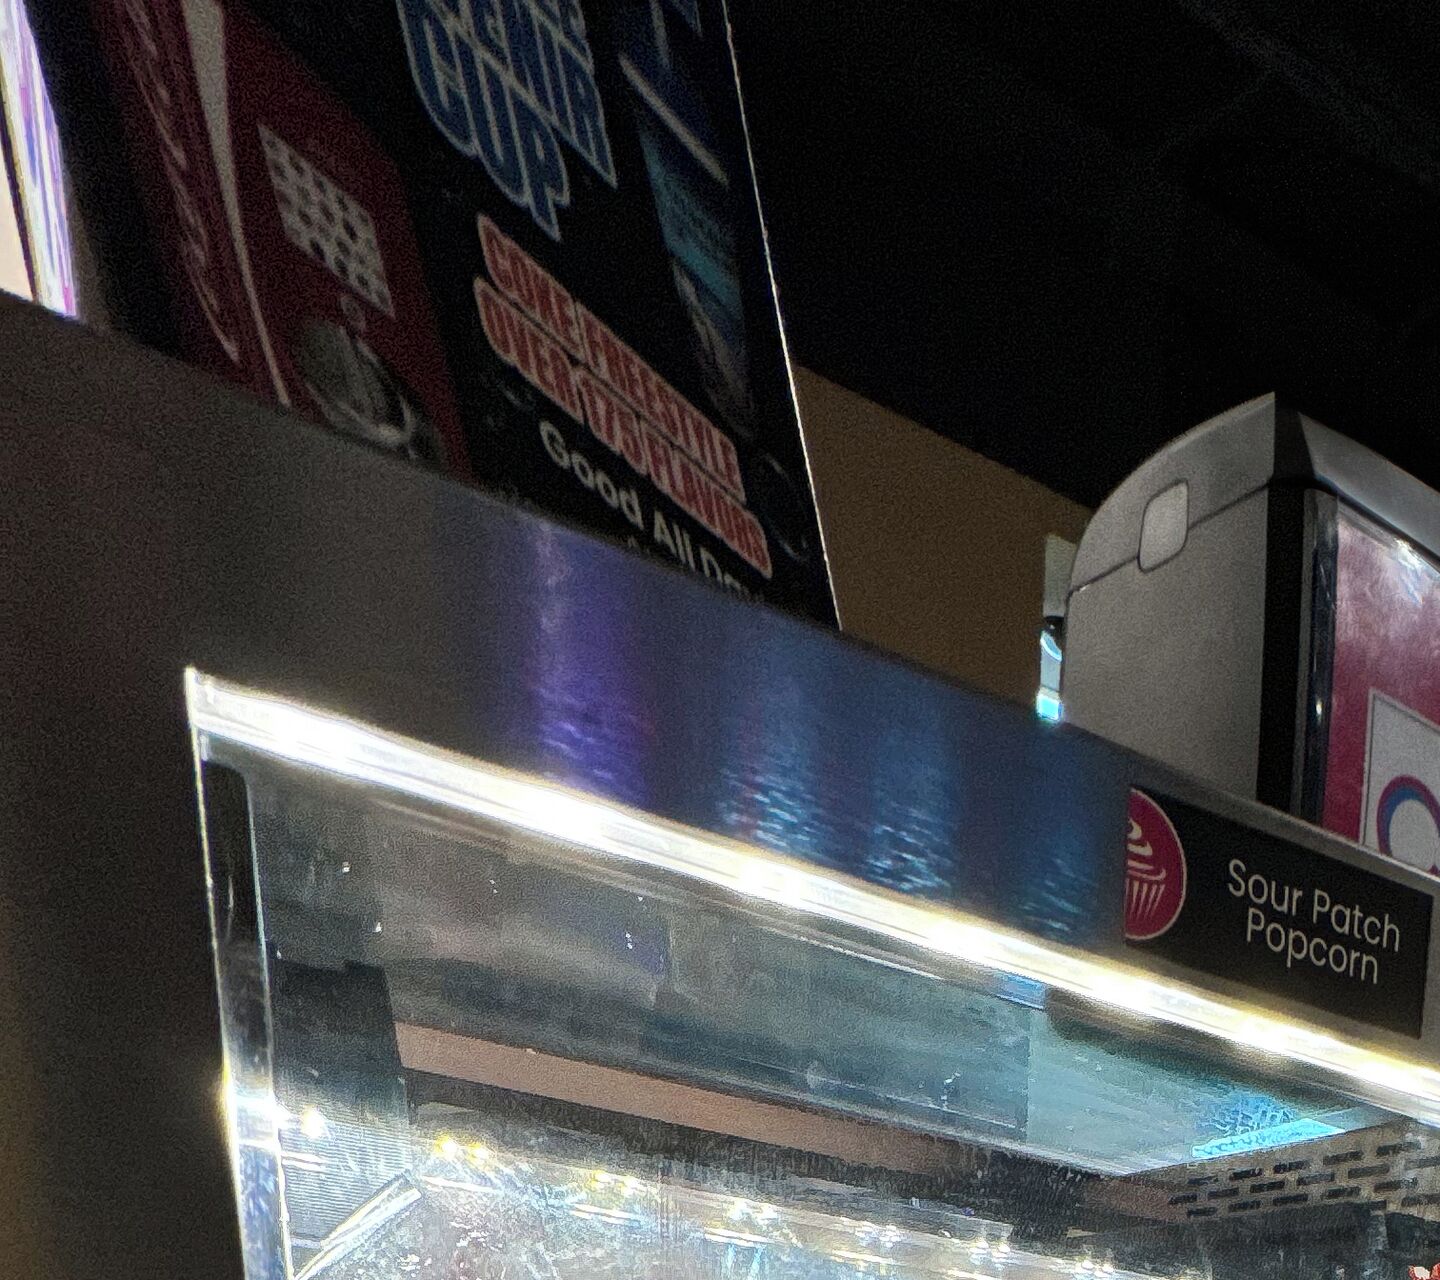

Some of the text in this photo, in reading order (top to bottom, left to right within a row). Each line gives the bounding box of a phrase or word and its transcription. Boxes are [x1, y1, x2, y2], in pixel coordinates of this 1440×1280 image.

[472, 273, 585, 426] OVER
[638, 412, 772, 580] FLAVORS
[573, 300, 747, 505] FREESTYLE
[539, 420, 644, 532] Good
[653, 508, 696, 573] All
[1228, 858, 1400, 952] Sour Patch
[1246, 907, 1378, 985] Popcorn
